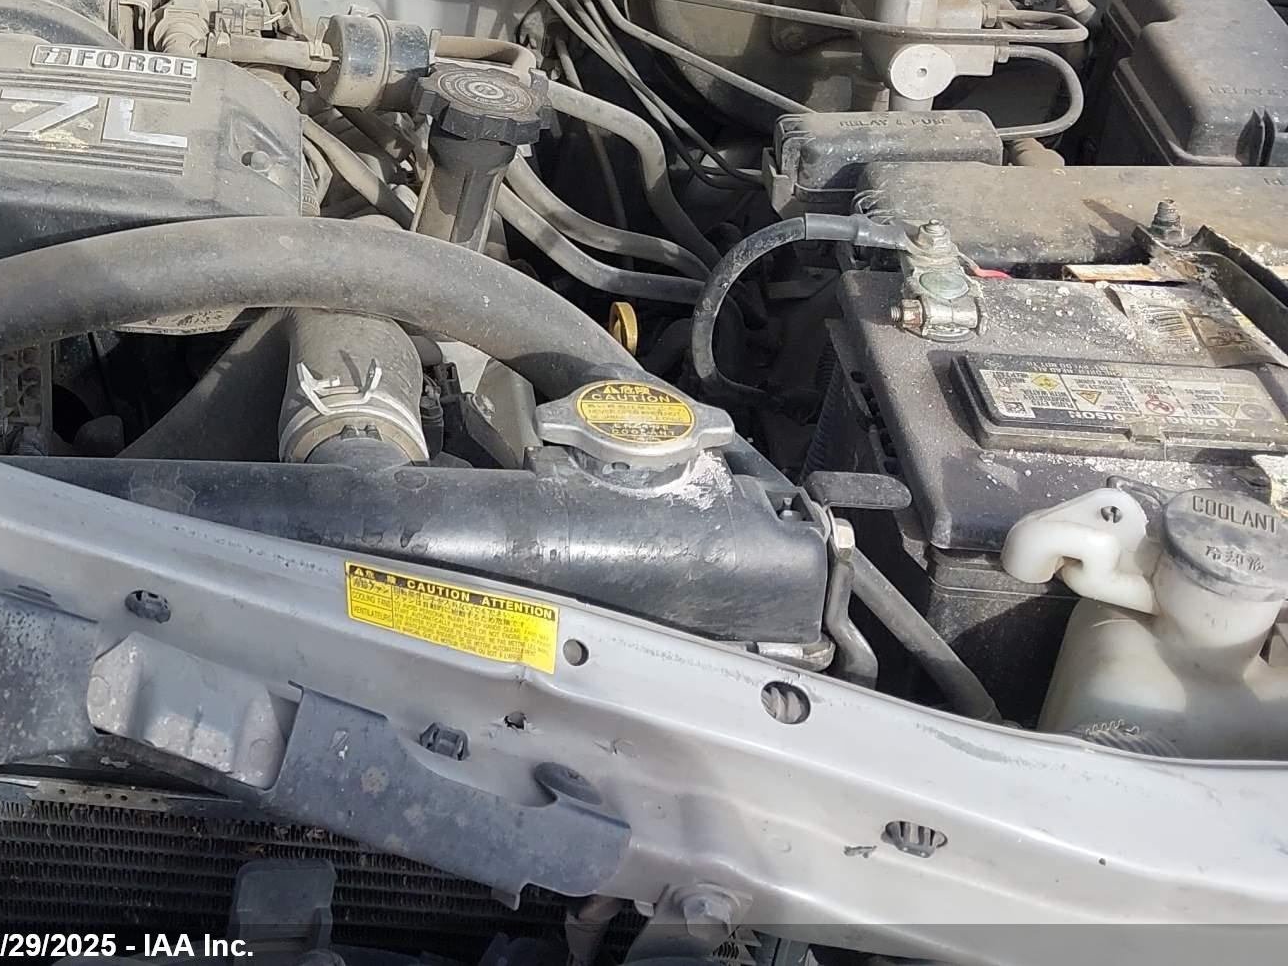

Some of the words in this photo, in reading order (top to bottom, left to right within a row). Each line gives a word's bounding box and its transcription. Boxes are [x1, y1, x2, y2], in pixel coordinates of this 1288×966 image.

[75, 49, 195, 78] FORCE
[839, 119, 888, 127] RELAY
[592, 393, 671, 403] CAUTION
[1067, 409, 1126, 421] OISON
[1192, 495, 1277, 533] COOLANT
[406, 580, 470, 601] CAUTION
[482, 597, 552, 619] ATTENTION
